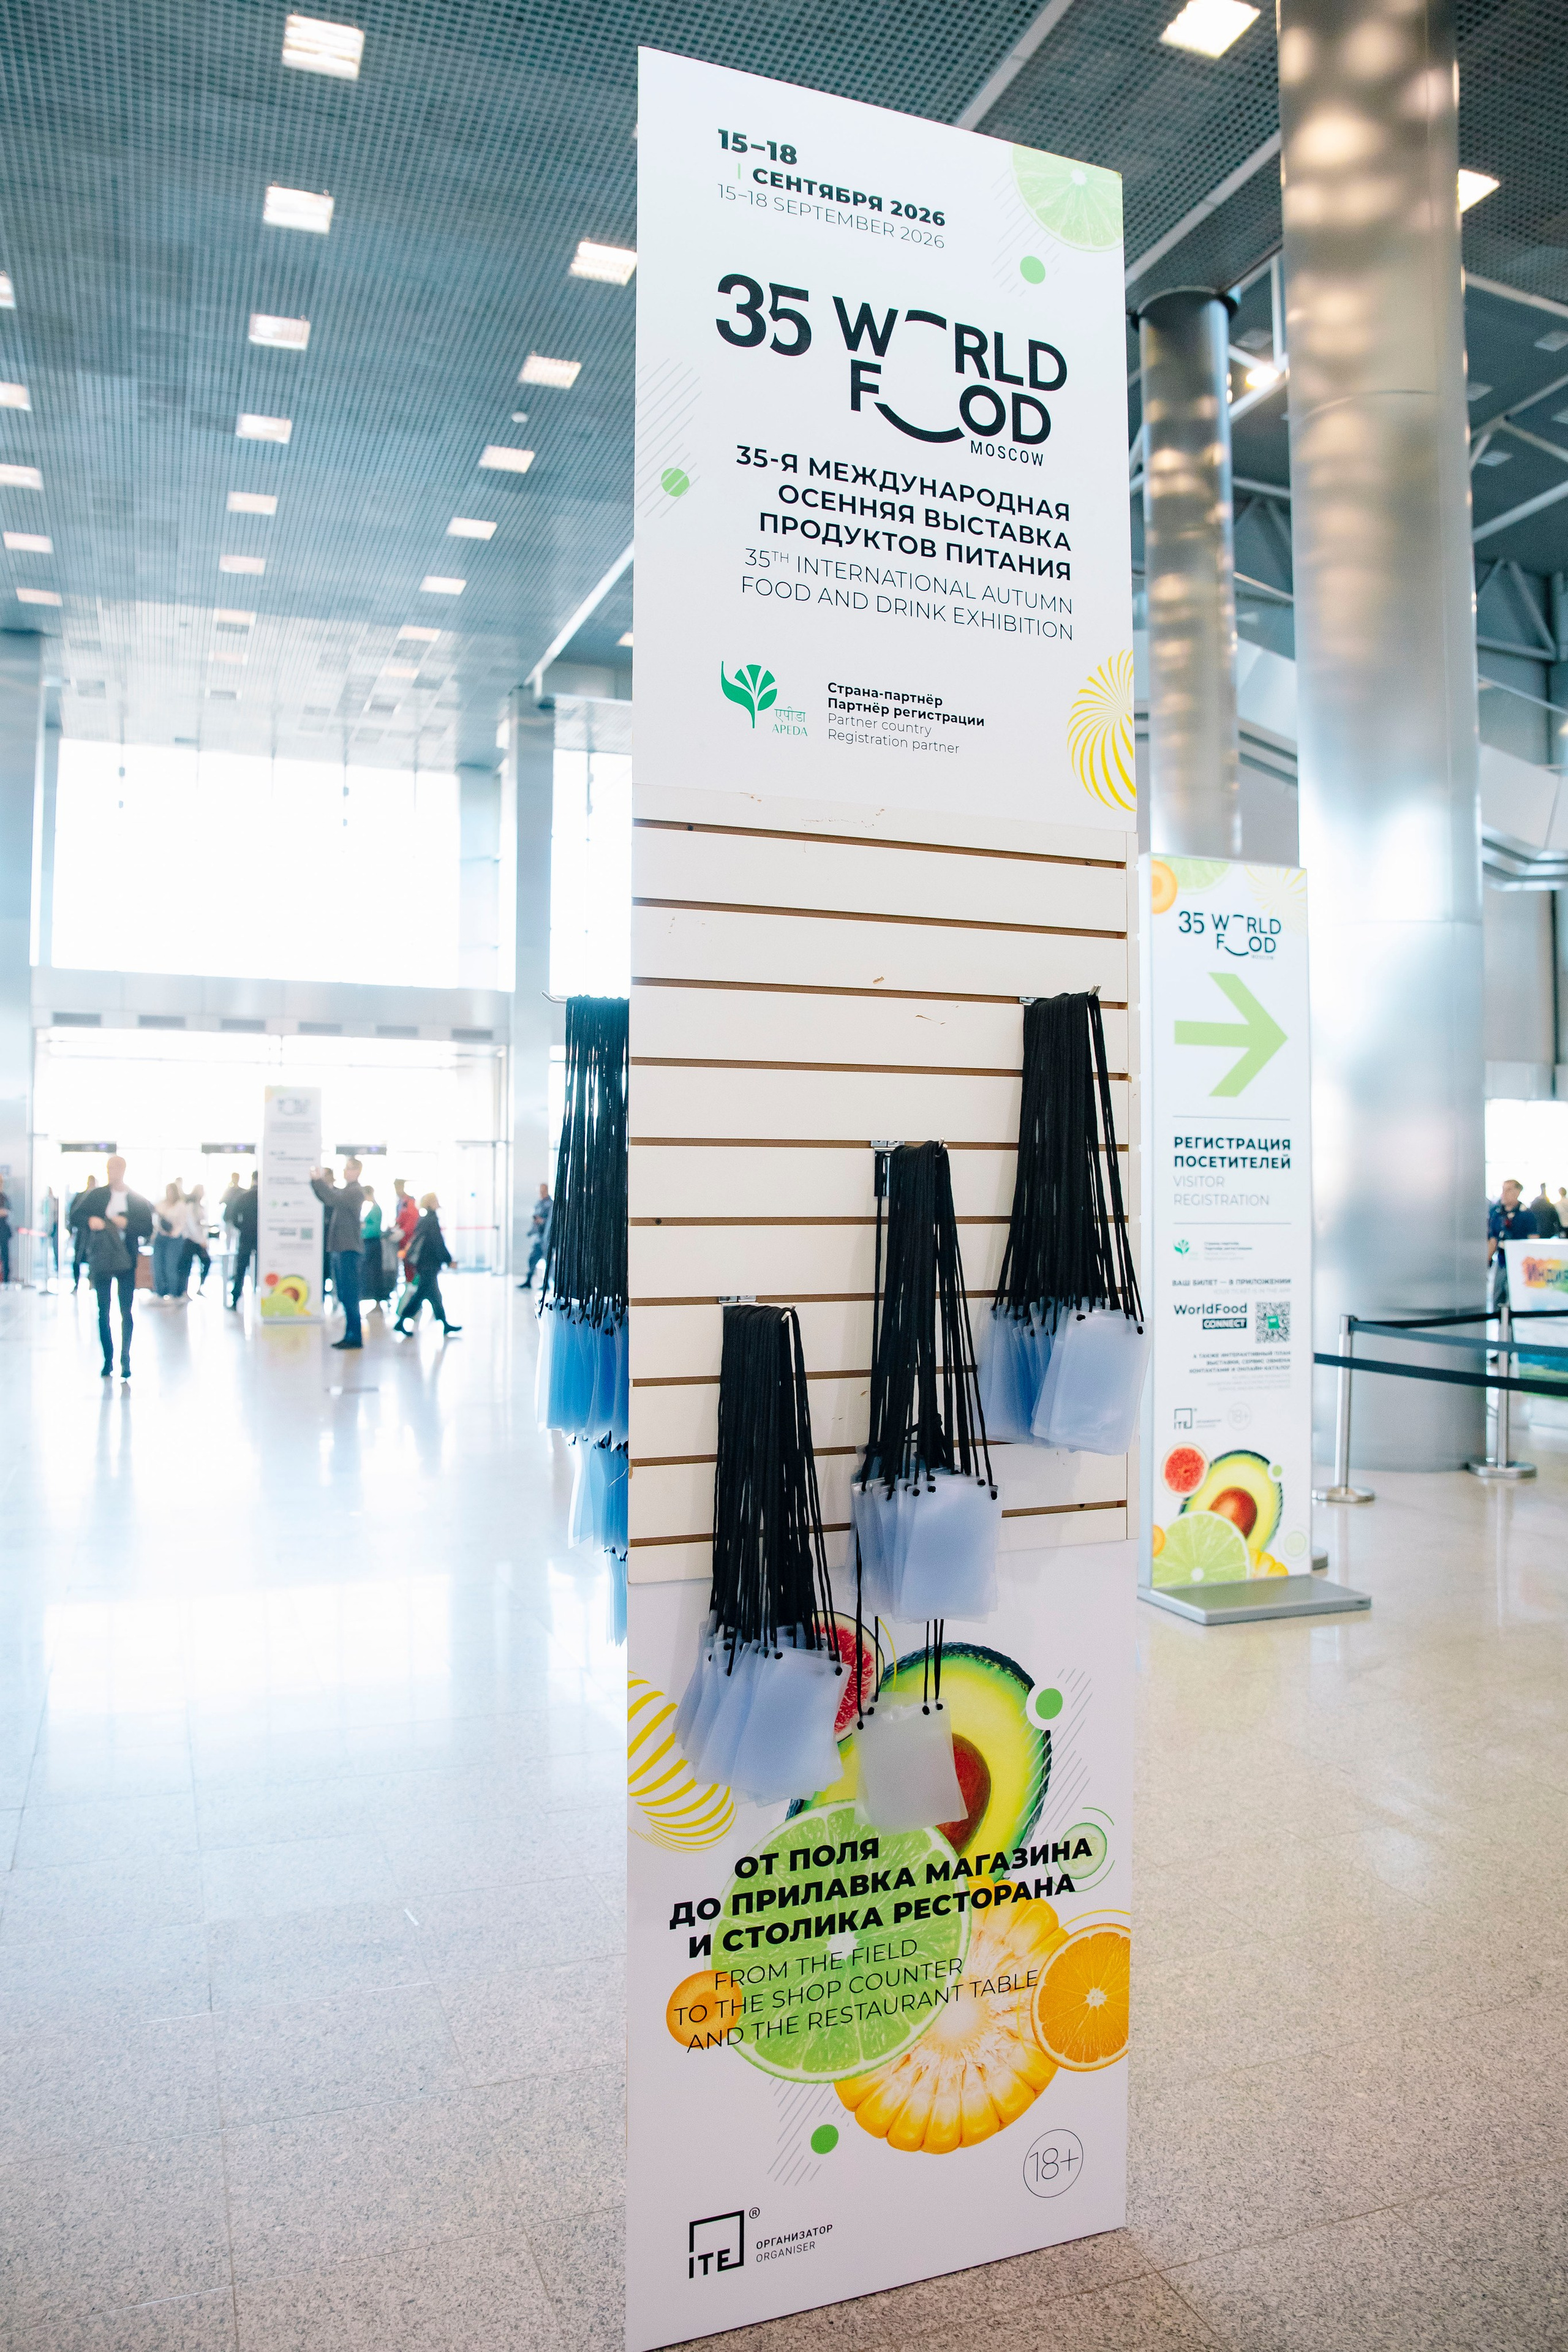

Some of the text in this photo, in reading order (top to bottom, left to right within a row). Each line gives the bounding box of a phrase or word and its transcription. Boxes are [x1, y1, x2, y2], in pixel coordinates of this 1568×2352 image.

[753, 168, 945, 226] СЕНТЯБРЯ 2026
[774, 197, 894, 237] SEPTEMBER
[900, 227, 944, 249] 2026
[716, 273, 812, 356] 35
[971, 440, 1043, 466] MOSCOW
[736, 445, 1069, 521] 35-Я МЕЖДУНАРОДНАЯ
[778, 484, 1071, 551] ОСЕННЯЯ ВЫСТАВКА
[760, 512, 1071, 581] ПРОДУКТОВ ПИТАНИЯ
[798, 556, 976, 600] INTERNATIONAL
[982, 586, 1071, 614] AUTUMN
[742, 576, 1072, 641] FOOD AND DRINK EXHIBITION
[827, 682, 943, 706] Страна-партнёр
[828, 698, 984, 726] Партнёр регистрации
[828, 712, 932, 738] Partner country
[772, 724, 807, 736] APEDA
[828, 729, 960, 754] Registration partner
[1179, 911, 1204, 934] 35
[1174, 1136, 1291, 1152] РЕГИСТРАЦИЯ
[1174, 1154, 1291, 1169] ПОСЕТИТЕЛЕЙ
[1173, 1175, 1225, 1188] VISITOR
[1174, 1194, 1270, 1206] REGISTRATION
[1174, 1303, 1248, 1315] WorldFood
[1204, 1319, 1246, 1329] CONNECT
[735, 1838, 879, 1879] ОТ ПОЛЯ
[669, 1838, 1093, 1930] ДО ПРИЛАВКА МАГАЗИНА
[689, 1874, 1076, 1958] И СТОЛИКА РЕСТОРАНА
[715, 1939, 917, 1990] FROM THE FIELD
[674, 1958, 962, 2025] TO THE SHOP COUNTER
[687, 1969, 1038, 2053] AND THE RESTAURANT TABLE
[1029, 2147, 1079, 2182] 18+
[756, 2224, 833, 2250] ОРГАНИЗАТОР
[756, 2241, 816, 2263] ORGANISER
